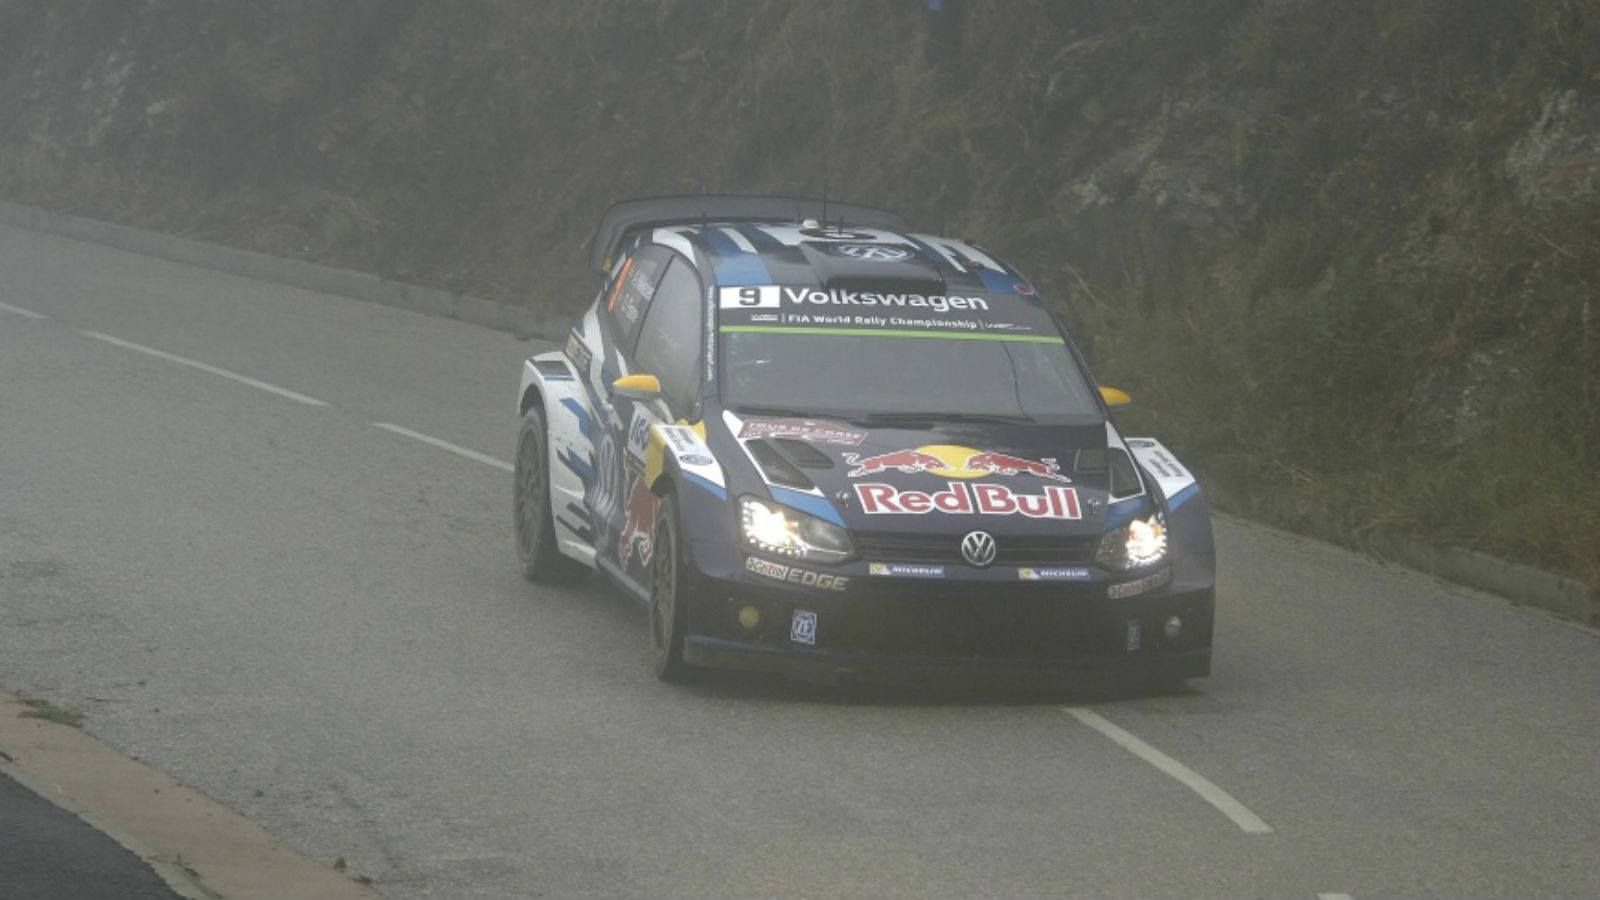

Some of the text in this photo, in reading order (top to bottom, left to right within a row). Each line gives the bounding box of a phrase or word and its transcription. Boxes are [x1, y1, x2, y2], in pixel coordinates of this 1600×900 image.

[739, 287, 990, 312] 9 Volkswagen
[788, 314, 810, 323] FIA
[812, 314, 851, 324] World
[854, 315, 886, 327] Rally
[889, 317, 978, 329] Championship
[855, 481, 1083, 520] Red Bull
[787, 567, 850, 591] EDGE
[1041, 567, 1088, 577] MICHELIN
